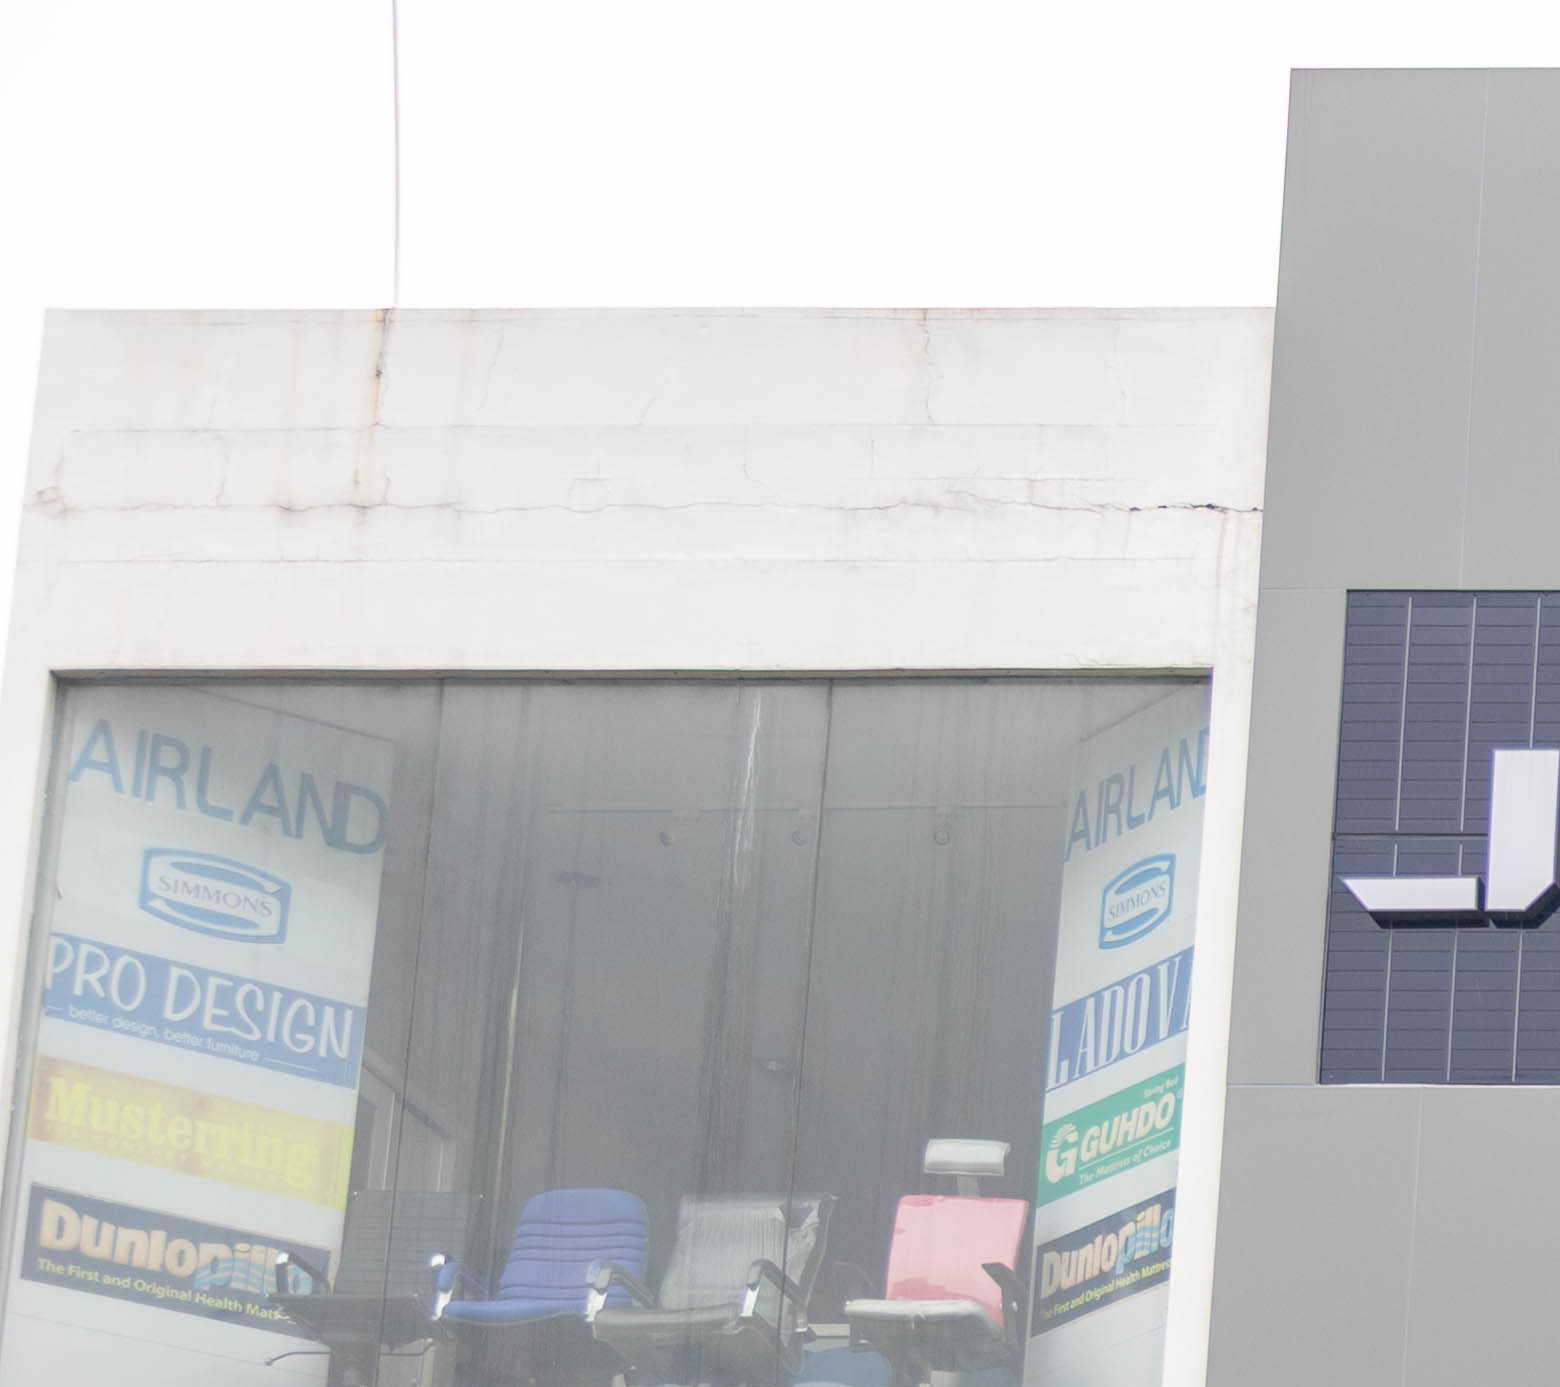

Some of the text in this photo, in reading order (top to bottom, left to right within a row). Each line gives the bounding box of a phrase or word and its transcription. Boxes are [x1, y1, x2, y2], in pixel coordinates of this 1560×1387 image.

[68, 718, 388, 856] AIRLAND
[157, 872, 273, 920] SIMMONS
[1106, 880, 1168, 925] SIMMONS
[45, 932, 353, 1059] PRO DESIGN
[68, 1004, 108, 1025] better
[163, 1027, 205, 1048] better
[207, 1039, 260, 1062] furniture
[1047, 955, 1192, 1091] LADOV
[45, 1075, 320, 1189] Musterring
[1081, 1093, 1176, 1162] GUHDO
[37, 1257, 65, 1275] The
[68, 1264, 100, 1283] First
[103, 1272, 132, 1289] and
[135, 1279, 193, 1303] Original
[195, 1291, 242, 1314] Health
[1041, 1203, 1174, 1299] Dunlopillo
